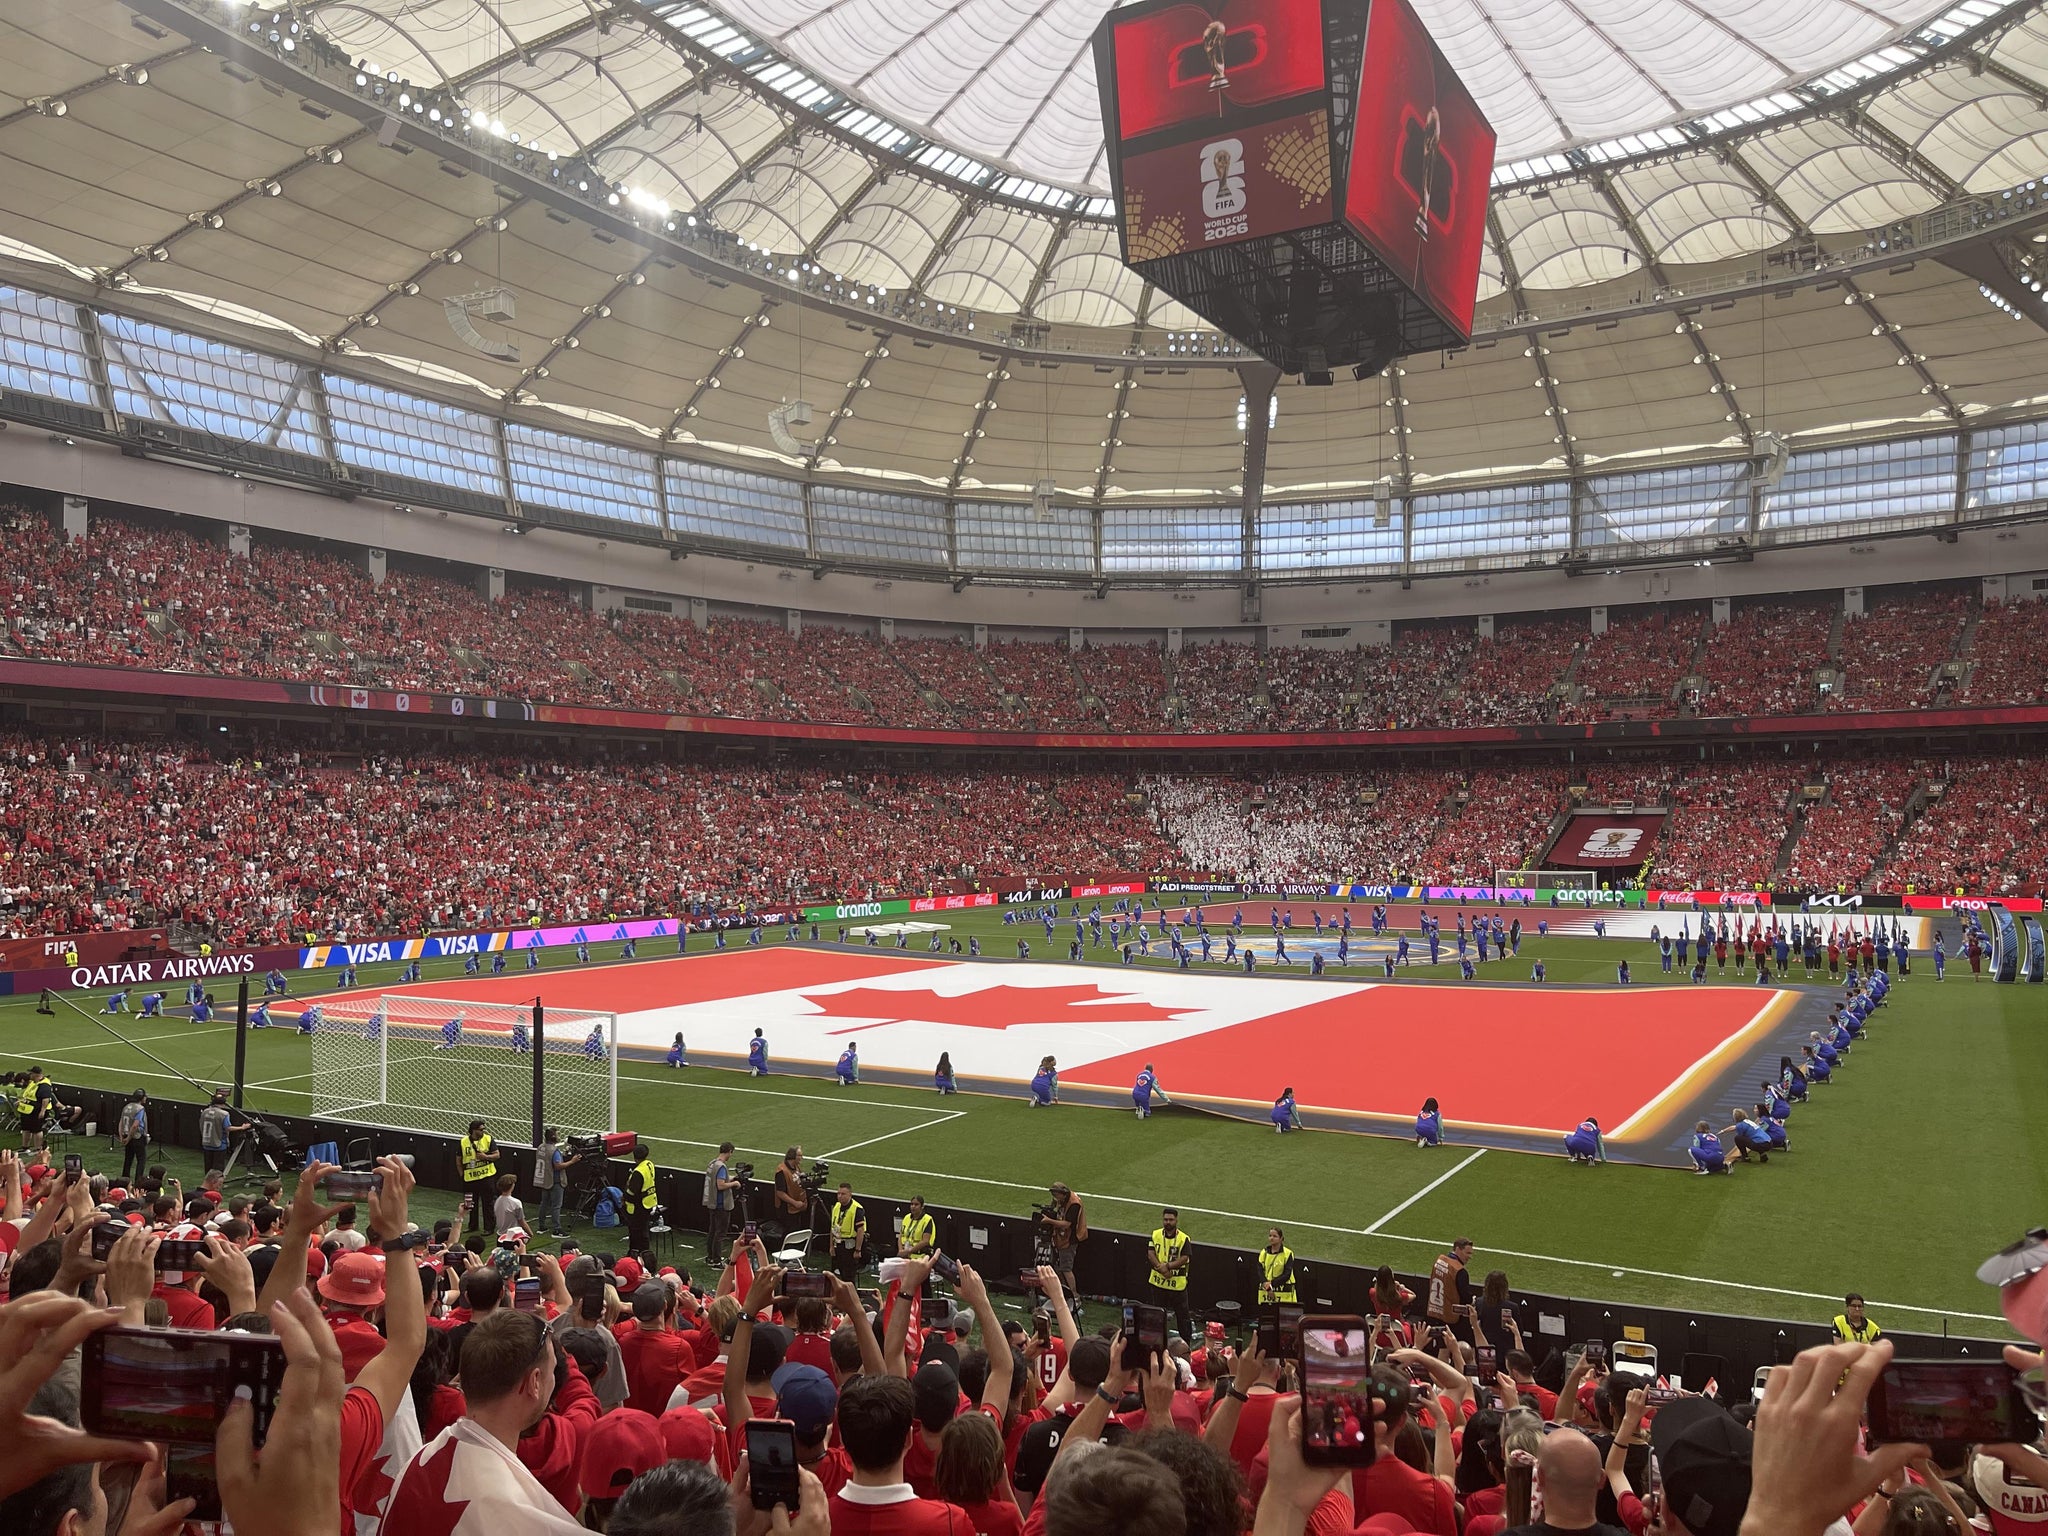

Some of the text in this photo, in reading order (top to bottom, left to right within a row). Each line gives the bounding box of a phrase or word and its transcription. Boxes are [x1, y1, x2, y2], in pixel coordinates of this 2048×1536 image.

[1214, 199, 1236, 211] FIFA
[1204, 213, 1248, 230] WORLD CUP
[1204, 222, 1249, 241] 2026
[315, 633, 327, 642] 441
[396, 694, 465, 715] 0 0
[1929, 785, 1943, 793] 203
[1081, 885, 1130, 896] Lenovo Lenovo
[1160, 883, 1180, 892] ADI
[1282, 885, 1327, 895] AIRWAYS
[1364, 886, 1393, 897] VISA
[836, 903, 882, 918] aramco
[1942, 897, 1998, 910] Lenov
[45, 940, 78, 956] FIFA
[343, 941, 392, 963] VISA
[434, 935, 480, 955] VISA
[72, 954, 254, 989] QATAR AIRWAYS
